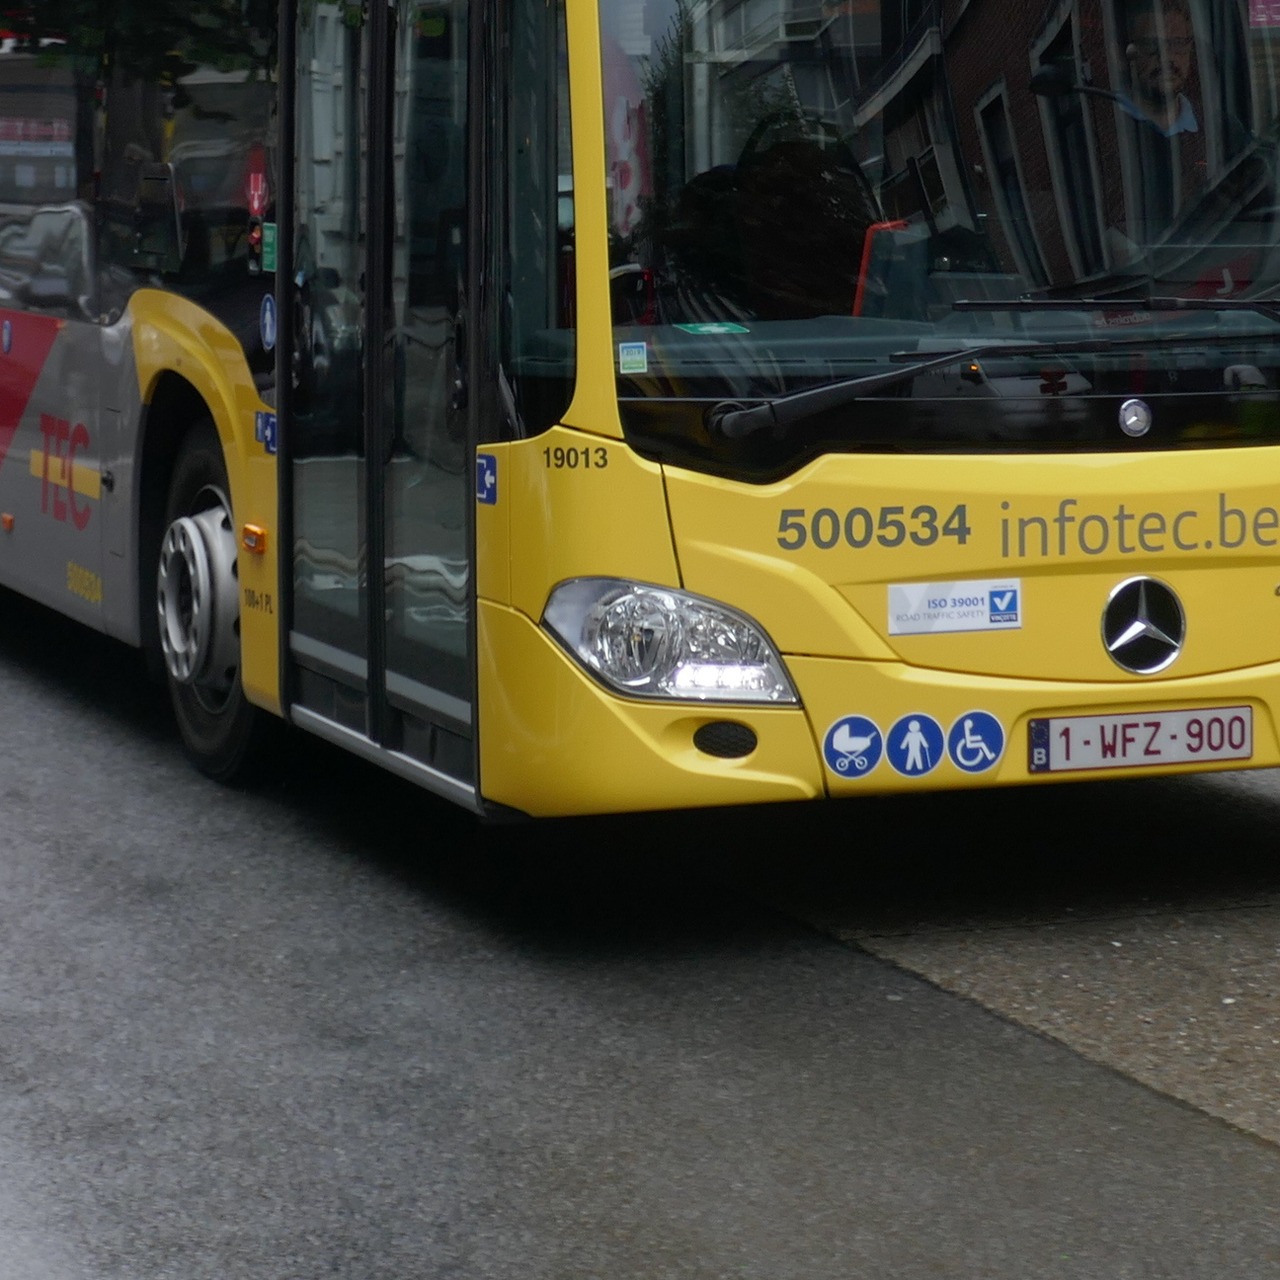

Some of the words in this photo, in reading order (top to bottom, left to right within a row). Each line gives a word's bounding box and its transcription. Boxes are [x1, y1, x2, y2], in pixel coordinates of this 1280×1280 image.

[39, 412, 92, 531] TEC
[542, 446, 609, 469] 19013
[776, 504, 971, 551] 500534
[1000, 492, 1280, 558] infotec.be
[896, 613, 920, 622] ROAD
[923, 611, 954, 621] TRAFFIC
[956, 610, 985, 620] SAFETY
[927, 598, 948, 609] ISO
[951, 596, 986, 609] 39001
[1032, 748, 1047, 765] B
[1059, 715, 1246, 762] 1-WFZ-900
